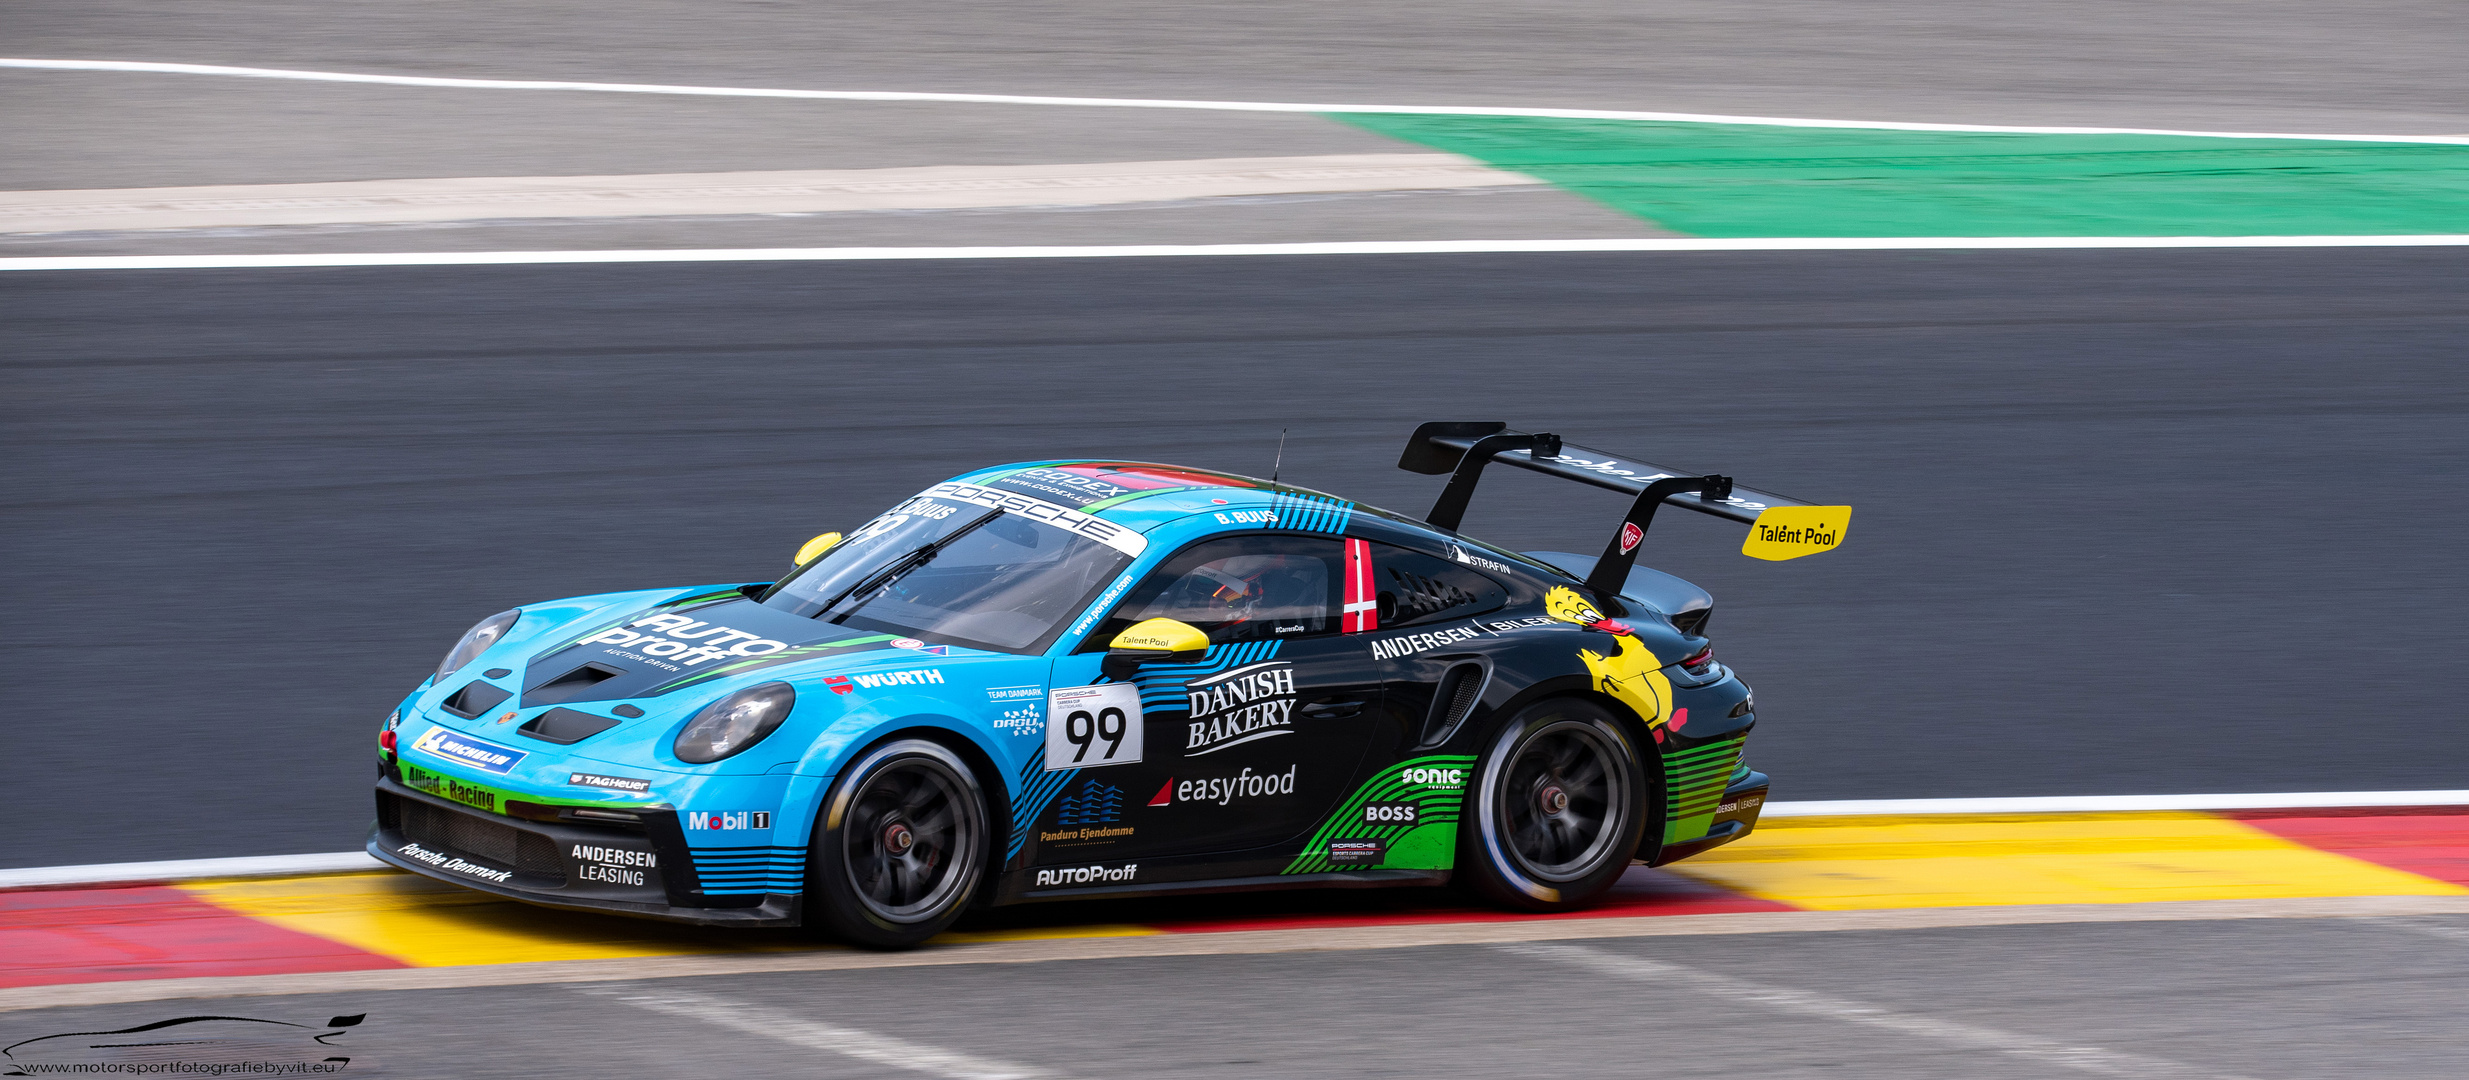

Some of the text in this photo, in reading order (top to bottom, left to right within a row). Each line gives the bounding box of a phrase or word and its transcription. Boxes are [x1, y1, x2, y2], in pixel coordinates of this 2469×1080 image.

[1026, 469, 1129, 496] CODEX
[900, 497, 957, 520] Buus
[928, 484, 1121, 541] PORSCHE
[1213, 510, 1279, 525] B. BUUS
[1759, 524, 1836, 546] Talent Pool
[1470, 555, 1511, 575] STRAFIN
[1072, 574, 1134, 636] www.porsche.com
[631, 613, 788, 657] AUTO
[1122, 636, 1169, 647] Talent Pool
[1275, 625, 1305, 634] #CarreraCup
[1370, 617, 1559, 661] ANDERSEN BILER
[603, 648, 681, 672] AUCTION DRIVEN
[853, 669, 945, 688] WÜRTH
[987, 688, 1043, 699] TEAM DANMARK
[1188, 668, 1297, 719] DANISH
[1065, 707, 1127, 763] 99
[1186, 699, 1297, 750] BAKERY
[440, 741, 512, 766] MICHELIN
[408, 766, 441, 795] Allied
[449, 779, 495, 812] Racing
[1177, 763, 1297, 806] easyfood
[688, 811, 748, 830] Mobil
[1366, 806, 1415, 821] BOSS
[1040, 826, 1135, 842] Panduro Ejendomme
[397, 843, 513, 883] Porsche Denmark
[571, 844, 657, 868] ANDERSEN
[579, 864, 644, 886] LEASING
